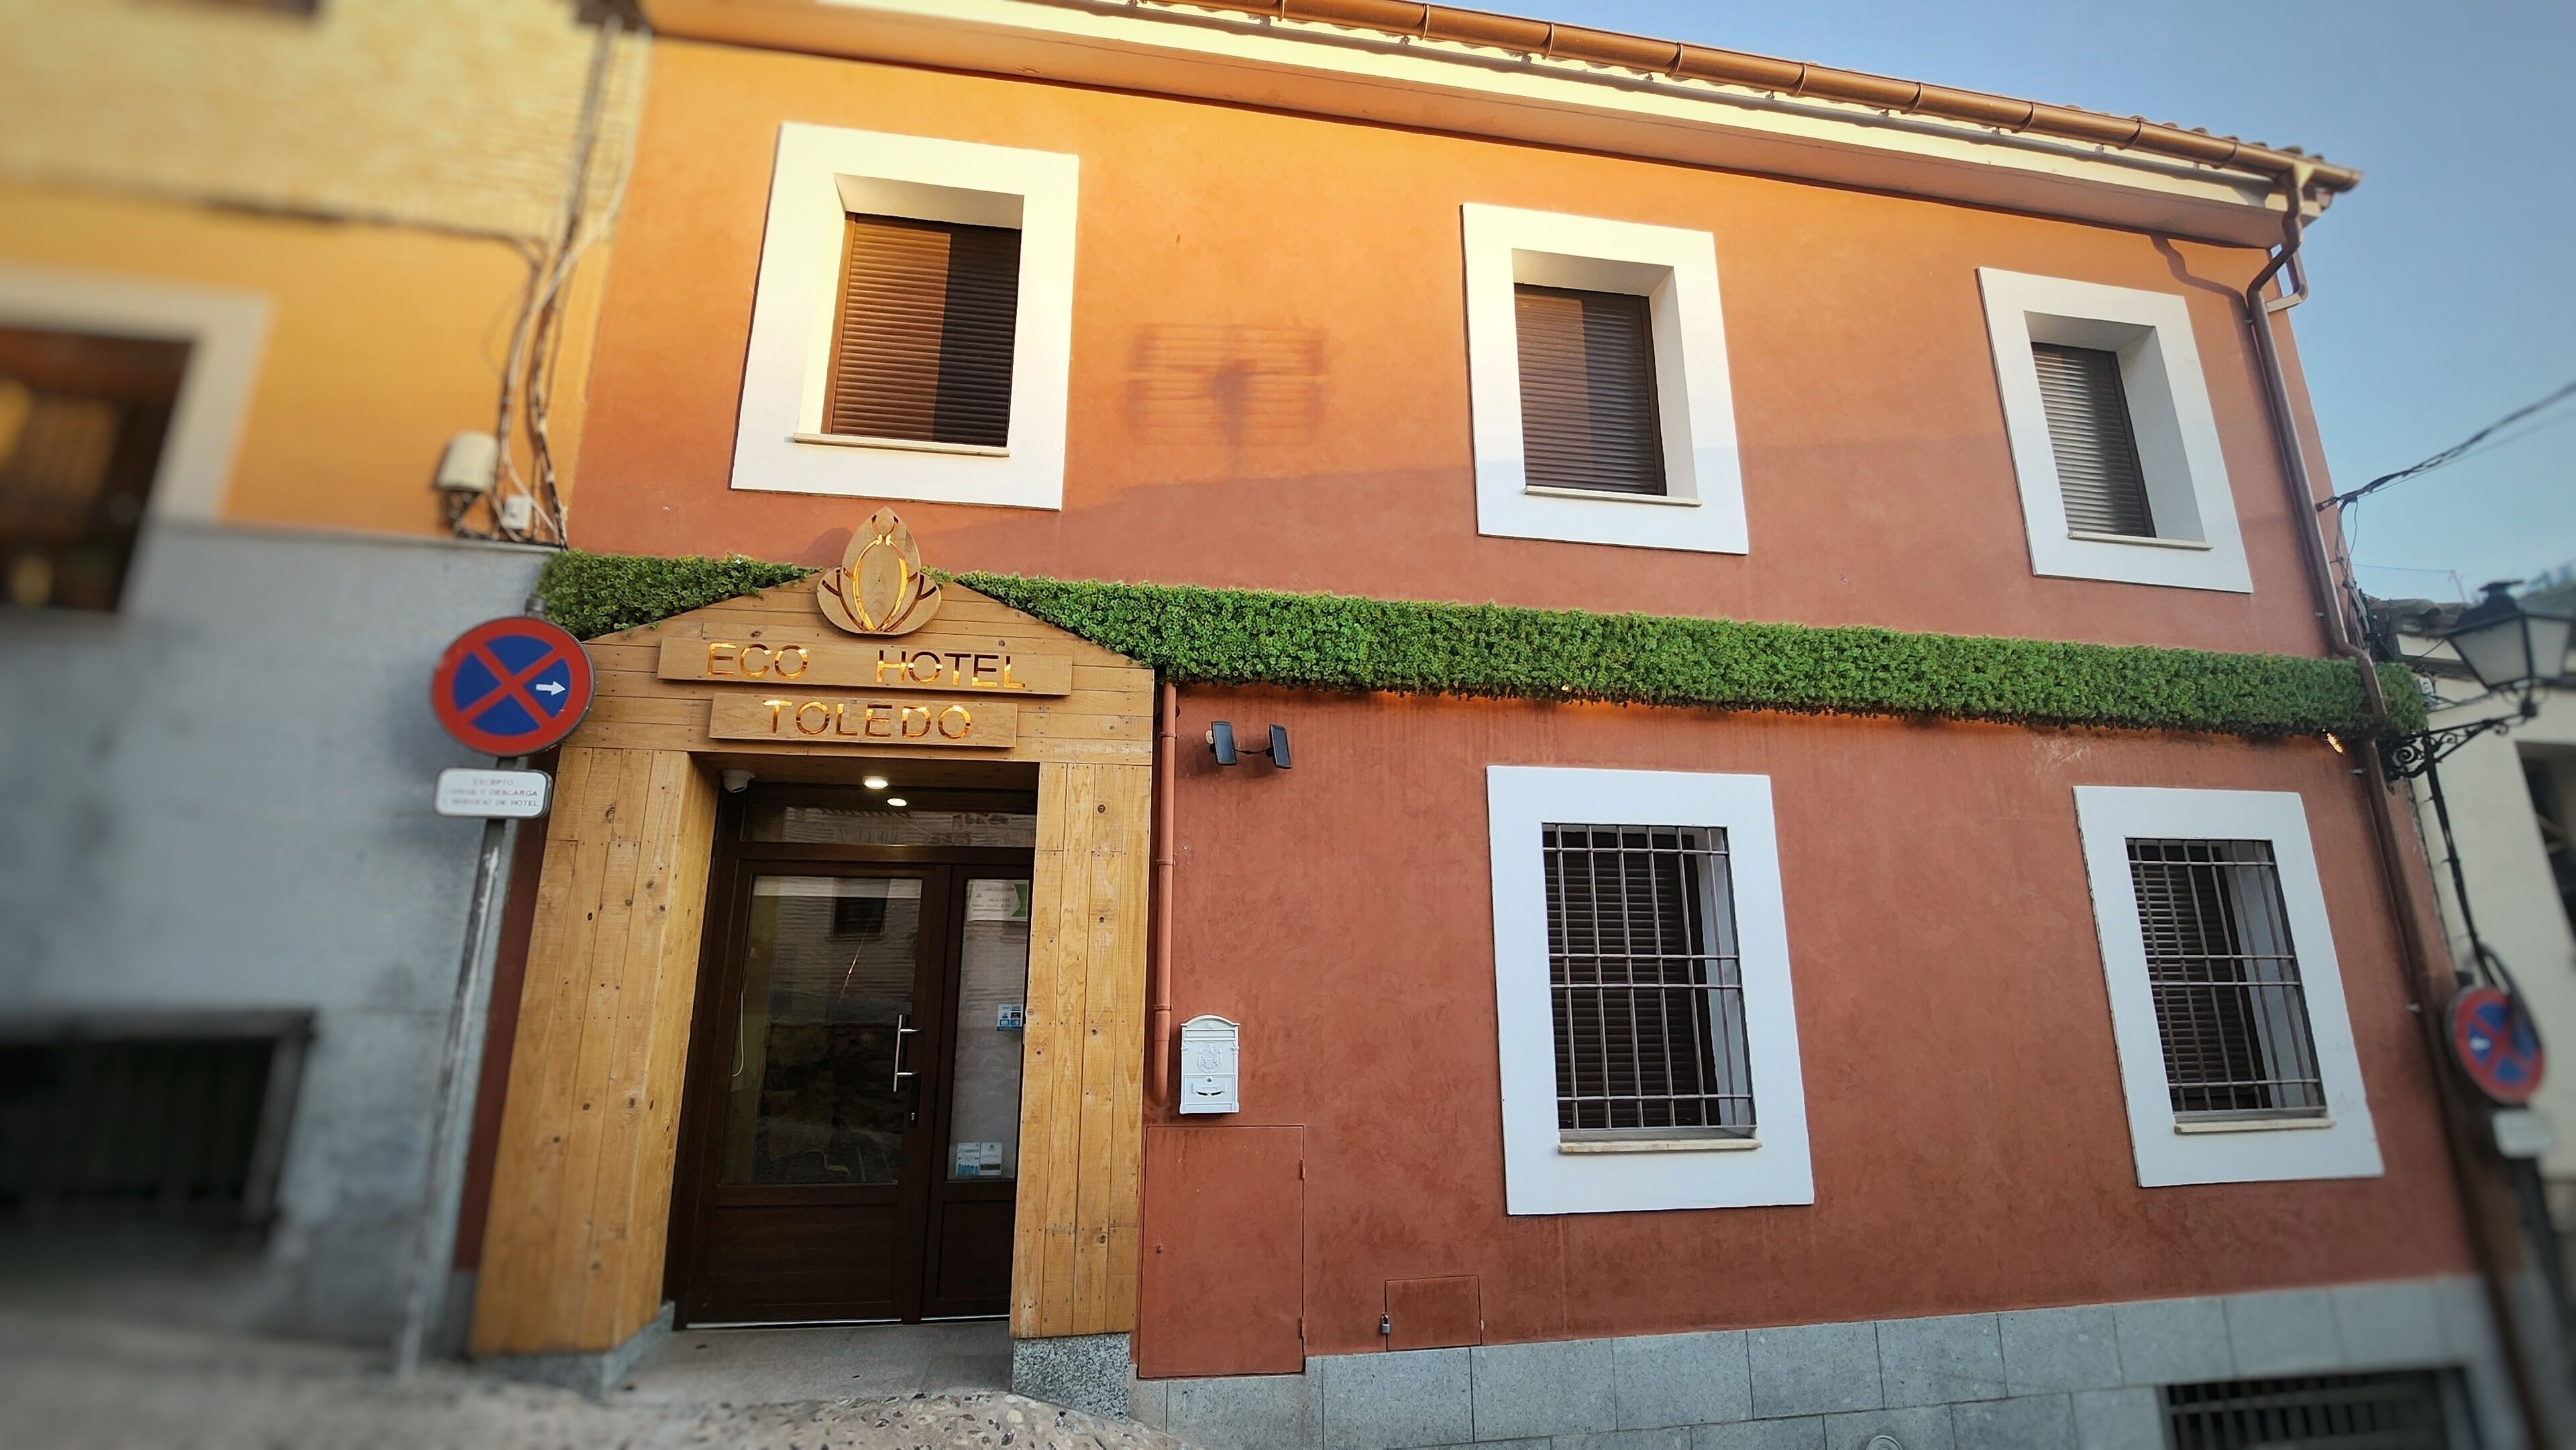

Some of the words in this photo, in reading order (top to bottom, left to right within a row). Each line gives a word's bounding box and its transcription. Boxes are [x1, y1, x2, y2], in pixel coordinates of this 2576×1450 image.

[708, 641, 809, 679] ECO
[875, 649, 1026, 689] HOTEL
[763, 699, 972, 739] TOLEDO
